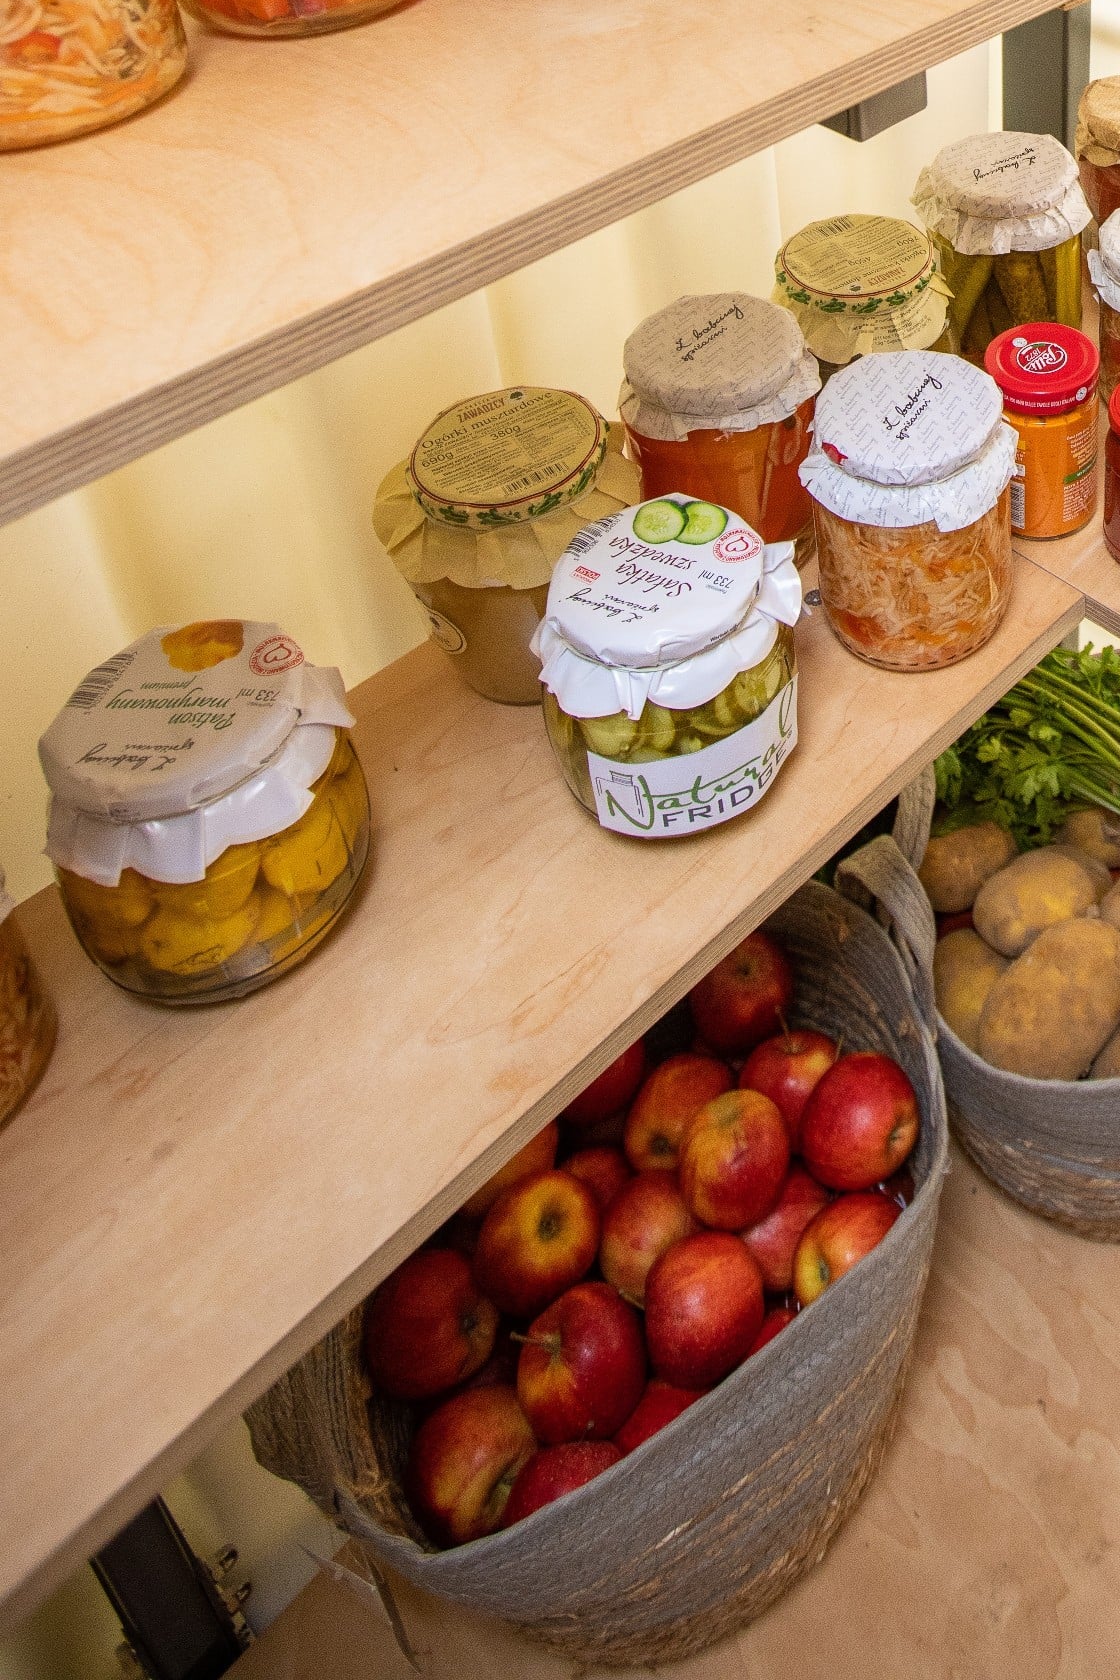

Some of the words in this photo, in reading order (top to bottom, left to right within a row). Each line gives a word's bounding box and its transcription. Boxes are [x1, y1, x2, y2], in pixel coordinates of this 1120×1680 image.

[1024, 347, 1041, 362] 1872
[1028, 343, 1065, 371] Polli
[422, 427, 468, 450] Ogórki
[470, 391, 553, 430] musztardowe
[490, 424, 521, 441] 380g
[422, 451, 454, 468] 690g
[608, 536, 697, 571] szwedzka
[616, 562, 692, 597] Sałatka
[697, 569, 714, 580] ml
[713, 574, 735, 589] 733
[106, 688, 231, 710] marynowany
[255, 690, 280, 703] 733
[168, 712, 236, 730] Patison
[605, 681, 794, 831] Natural
